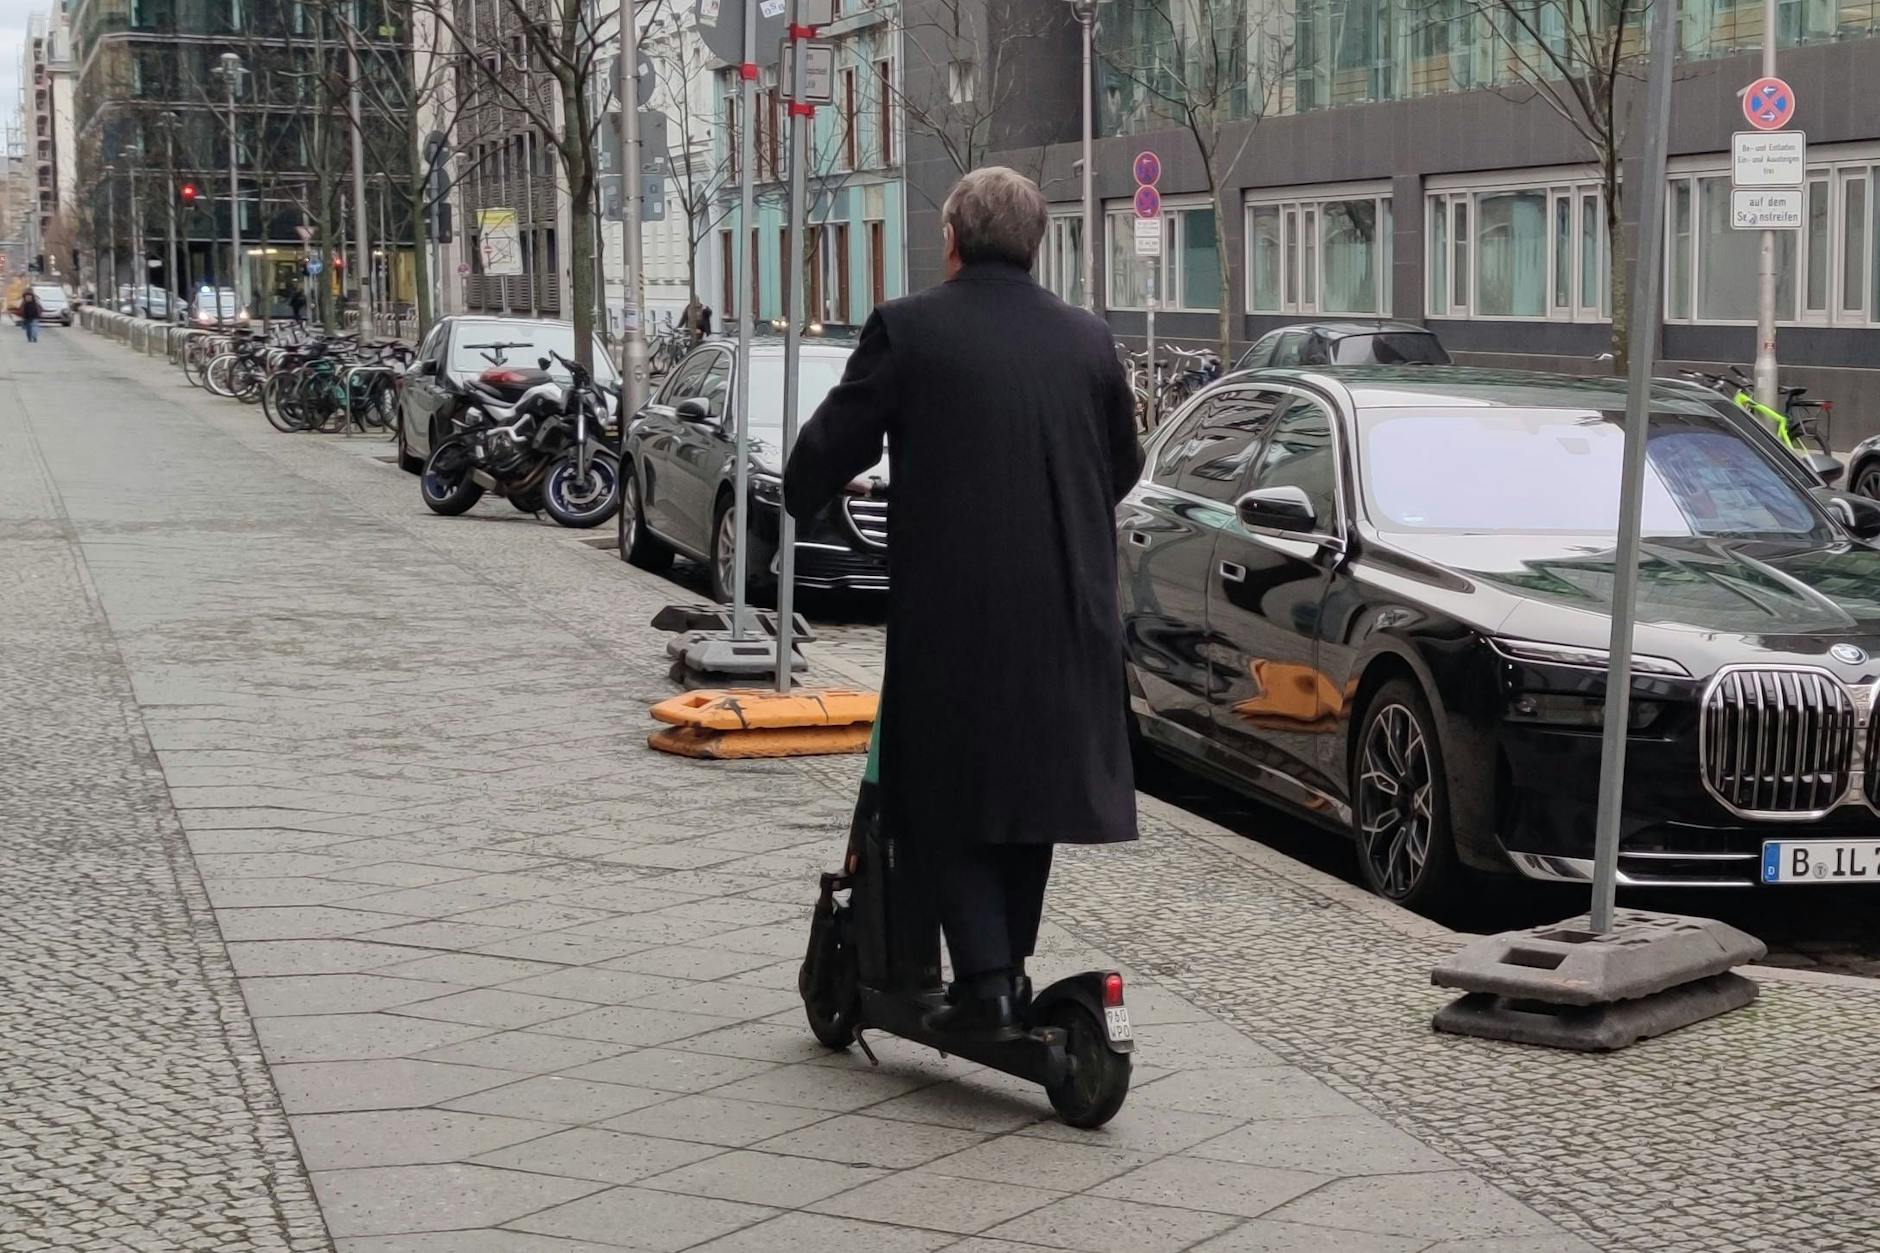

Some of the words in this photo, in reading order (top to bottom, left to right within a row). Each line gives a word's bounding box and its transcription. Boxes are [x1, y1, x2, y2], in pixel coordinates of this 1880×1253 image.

[1749, 196, 1764, 207] auf
[1768, 196, 1787, 207] dem
[1792, 847, 1810, 877] B
[1767, 866, 1776, 876] D
